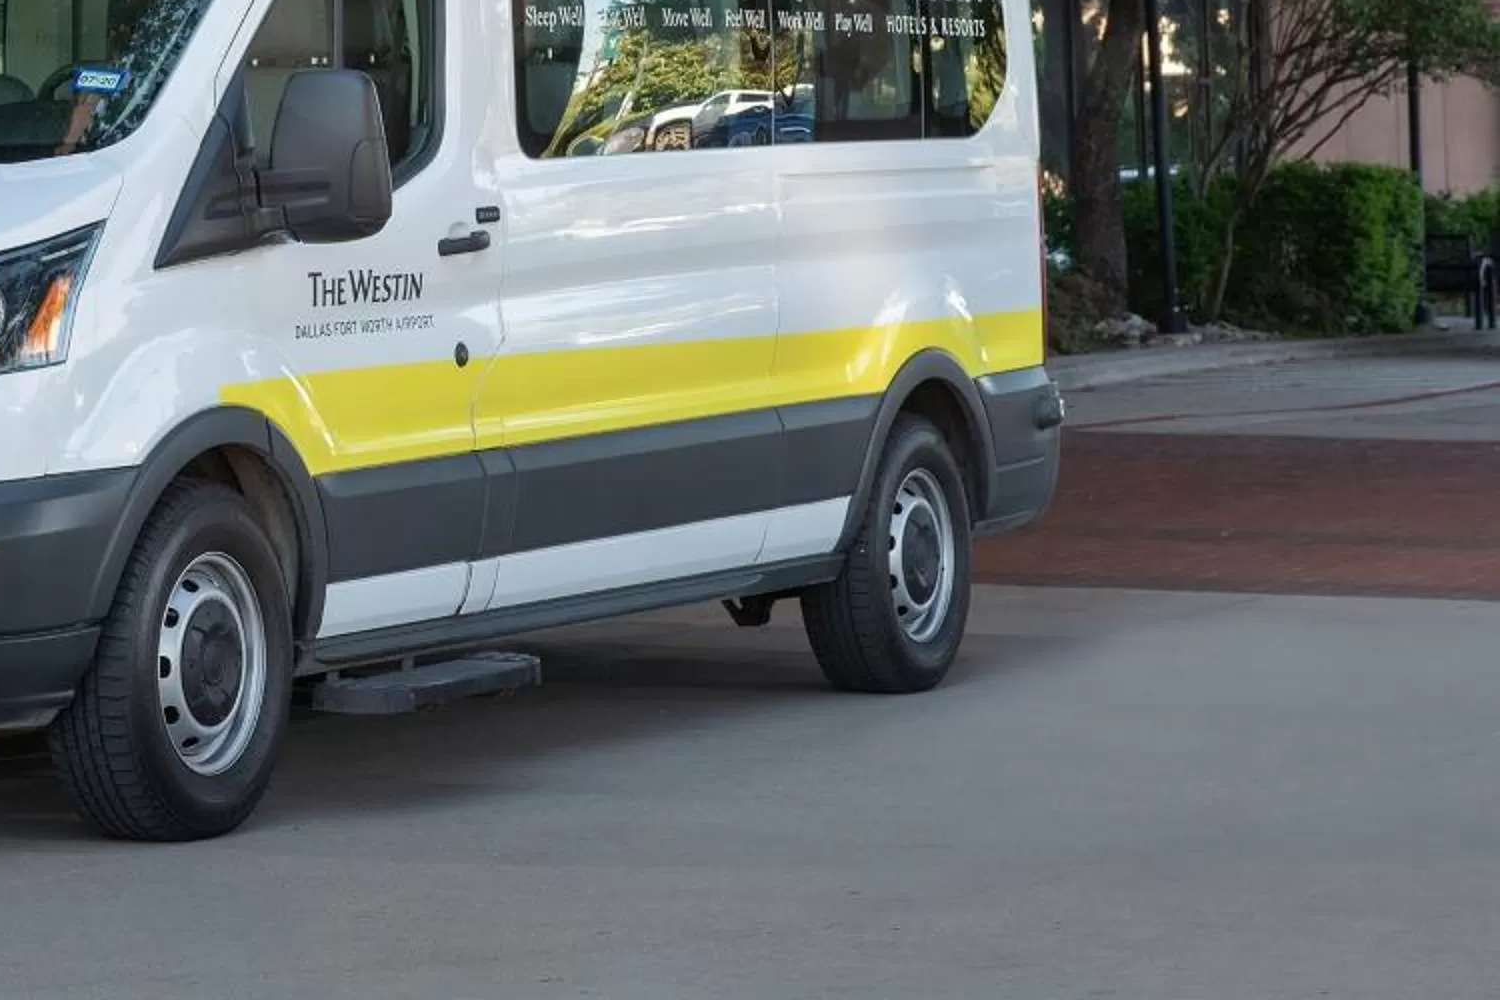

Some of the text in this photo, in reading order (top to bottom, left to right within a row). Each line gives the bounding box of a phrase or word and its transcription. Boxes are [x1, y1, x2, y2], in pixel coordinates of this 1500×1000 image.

[525, 5, 584, 32] Sleep Well
[661, 7, 713, 27] Move Well
[744, 9, 766, 29] Well
[886, 15, 985, 37] HOTELS & RESORTS
[307, 269, 423, 307] THE WESTIN
[295, 314, 435, 339] DALLAS FORT WORTH AIRPORT
